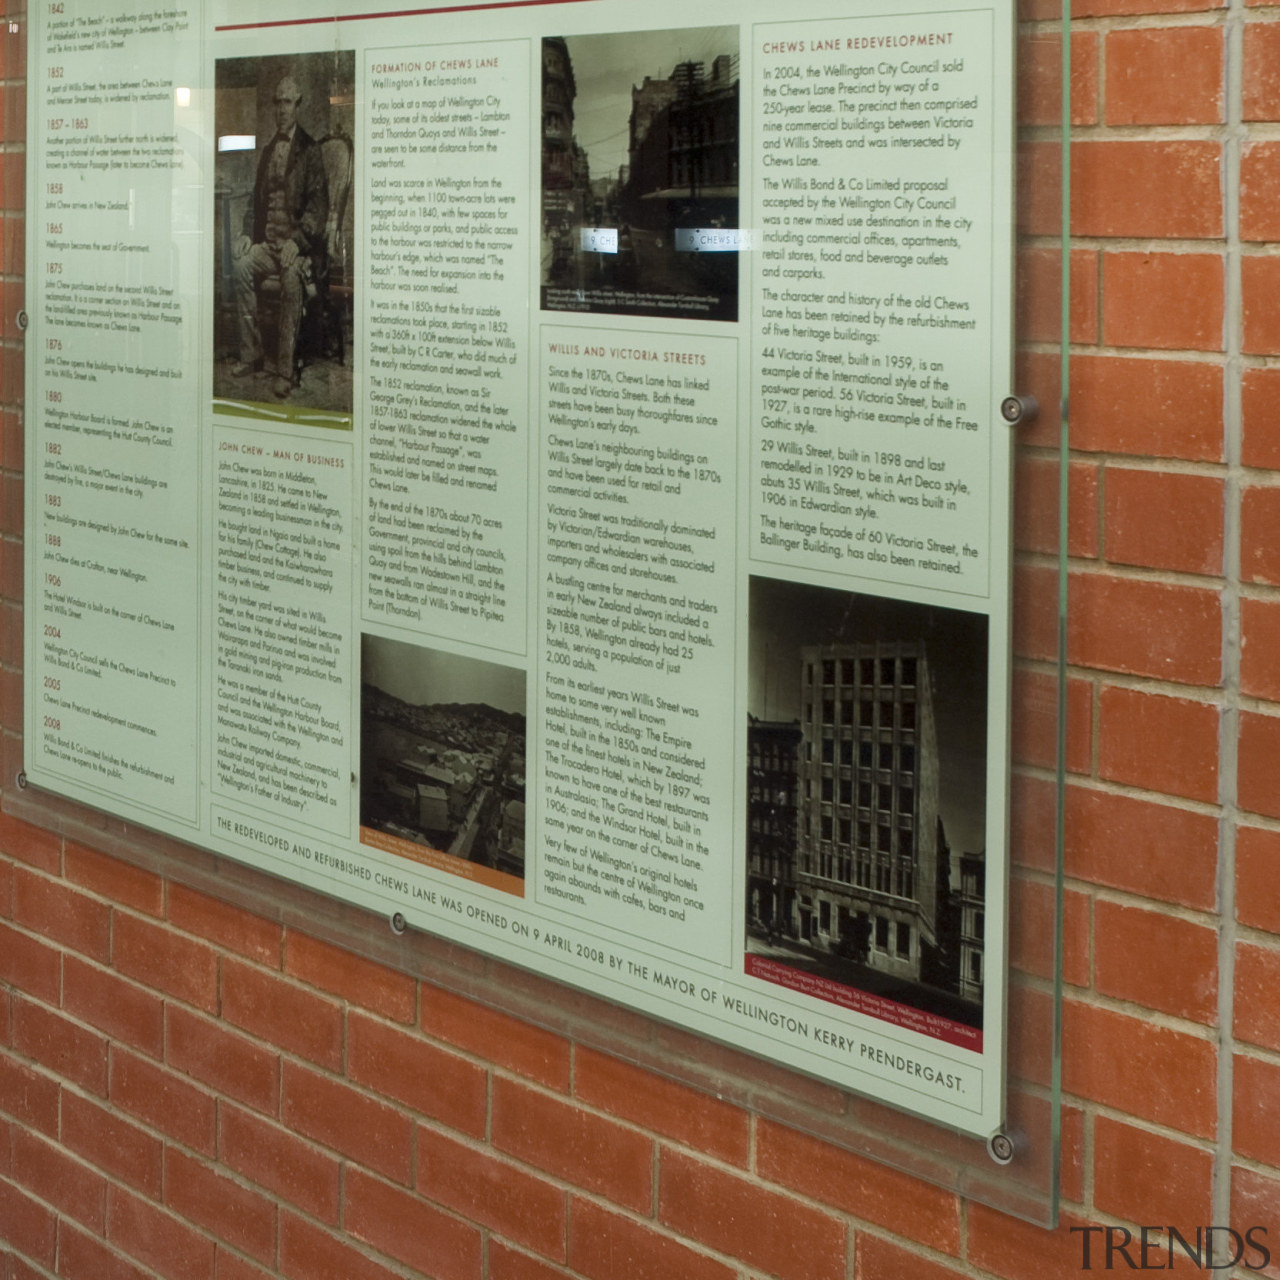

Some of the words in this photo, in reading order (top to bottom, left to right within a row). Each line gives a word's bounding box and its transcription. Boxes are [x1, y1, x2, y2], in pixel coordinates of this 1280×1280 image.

[48, 3, 64, 15] 1842
[762, 40, 805, 54] CHEWS
[810, 38, 841, 52] LANE
[846, 32, 953, 50] REDEVELOPMENT
[371, 62, 422, 74] FORMATION
[424, 60, 436, 72] OF
[439, 58, 472, 71] CHEWS
[475, 56, 498, 69] LANE
[763, 68, 772, 80] In
[774, 66, 804, 80] 2004,
[806, 65, 822, 78] the
[822, 63, 875, 80] Wellington
[877, 61, 898, 78] City
[900, 59, 940, 75] Council
[942, 58, 964, 73] sold
[371, 77, 420, 90] Wellington's
[422, 75, 477, 87] Reclamations
[762, 84, 778, 97] the
[778, 83, 811, 97] Chews
[813, 83, 836, 96] Lane
[838, 81, 877, 95] Precinct
[878, 80, 892, 97] by
[893, 83, 916, 96] way
[917, 79, 930, 93] of
[931, 82, 940, 92] a
[371, 98, 377, 110] If
[377, 102, 390, 112] you
[390, 98, 405, 110] look
[406, 100, 414, 109] at
[414, 100, 421, 109] a
[421, 100, 438, 110] map
[438, 96, 446, 108] of
[446, 95, 485, 109] Wellington
[485, 94, 501, 108] City
[762, 101, 805, 117] 250-year
[807, 100, 835, 114] lease.
[838, 99, 856, 113] The
[858, 99, 898, 116] precinct
[899, 97, 922, 111] then
[923, 95, 978, 113] comprised
[371, 114, 392, 127] today,
[393, 116, 411, 125] some
[411, 113, 420, 124] of
[420, 114, 429, 124] its
[429, 112, 450, 124] oldest
[451, 113, 473, 123] streets
[480, 110, 511, 122] Lambton
[762, 121, 783, 132] nine
[784, 118, 839, 132] commercial
[841, 117, 886, 134] buildings
[887, 117, 931, 130] between
[933, 116, 974, 129] Victoria
[762, 136, 781, 150] and
[782, 136, 810, 149] Willis
[812, 136, 844, 149] Streets
[845, 135, 866, 149] and
[867, 139, 888, 148] was
[890, 134, 945, 148] intersected
[947, 134, 961, 151] by
[762, 154, 794, 167] Chews
[796, 154, 821, 167] Lane.
[46, 223, 63, 235] 1865
[46, 263, 63, 275] 1875
[45, 338, 63, 351] 1876
[548, 343, 580, 356] WILLIS
[583, 346, 606, 358] AND
[610, 348, 659, 362] VICTORIA
[663, 351, 706, 366] STREETS
[548, 365, 570, 379] Since
[570, 367, 584, 380] the
[586, 368, 614, 384] 1870s,
[615, 371, 644, 386] Chews
[645, 374, 665, 388] Lane
[666, 375, 682, 389] has
[683, 377, 710, 392] linked
[548, 381, 571, 395] Willis
[571, 384, 588, 397] and
[589, 385, 620, 400] Victoria
[621, 387, 650, 402] Streets.
[652, 390, 672, 404] Both
[673, 392, 696, 407] these
[548, 399, 573, 411] streets
[573, 400, 594, 413] have
[594, 402, 615, 415] been
[616, 403, 636, 420] busy
[636, 405, 694, 424] thoroughfares
[695, 415, 718, 427] since
[45, 442, 62, 455] 1882
[218, 441, 239, 453] JOHN
[241, 444, 264, 456] CHEW
[272, 449, 291, 461] MAN
[293, 451, 304, 463] OF
[306, 453, 345, 469] BUSINESS
[45, 493, 62, 507] 1883
[45, 573, 62, 587] 1906
[44, 625, 61, 639] 2004
[44, 676, 61, 691] 2005
[44, 716, 61, 731] 2008
[217, 816, 232, 832] THE
[234, 822, 290, 852] REDEVELOPED
[291, 843, 312, 860] AND
[314, 850, 372, 881] REFURBISHED
[374, 872, 409, 895] CHEWS
[412, 885, 437, 905] LANE
[440, 895, 463, 914] WAS
[466, 904, 508, 930] OPENED
[511, 920, 529, 938] ON
[533, 928, 540, 941] 9
[543, 932, 572, 954] APRIL
[576, 943, 605, 965] 2008
[609, 954, 623, 971] BY
[627, 960, 648, 981] THE
[652, 970, 696, 997] MAYOR
[700, 987, 717, 1004] OF
[722, 994, 808, 1038] WELLINGTON
[814, 1026, 855, 1053] KERRY
[860, 1042, 966, 1094] PRENDERGAST.
